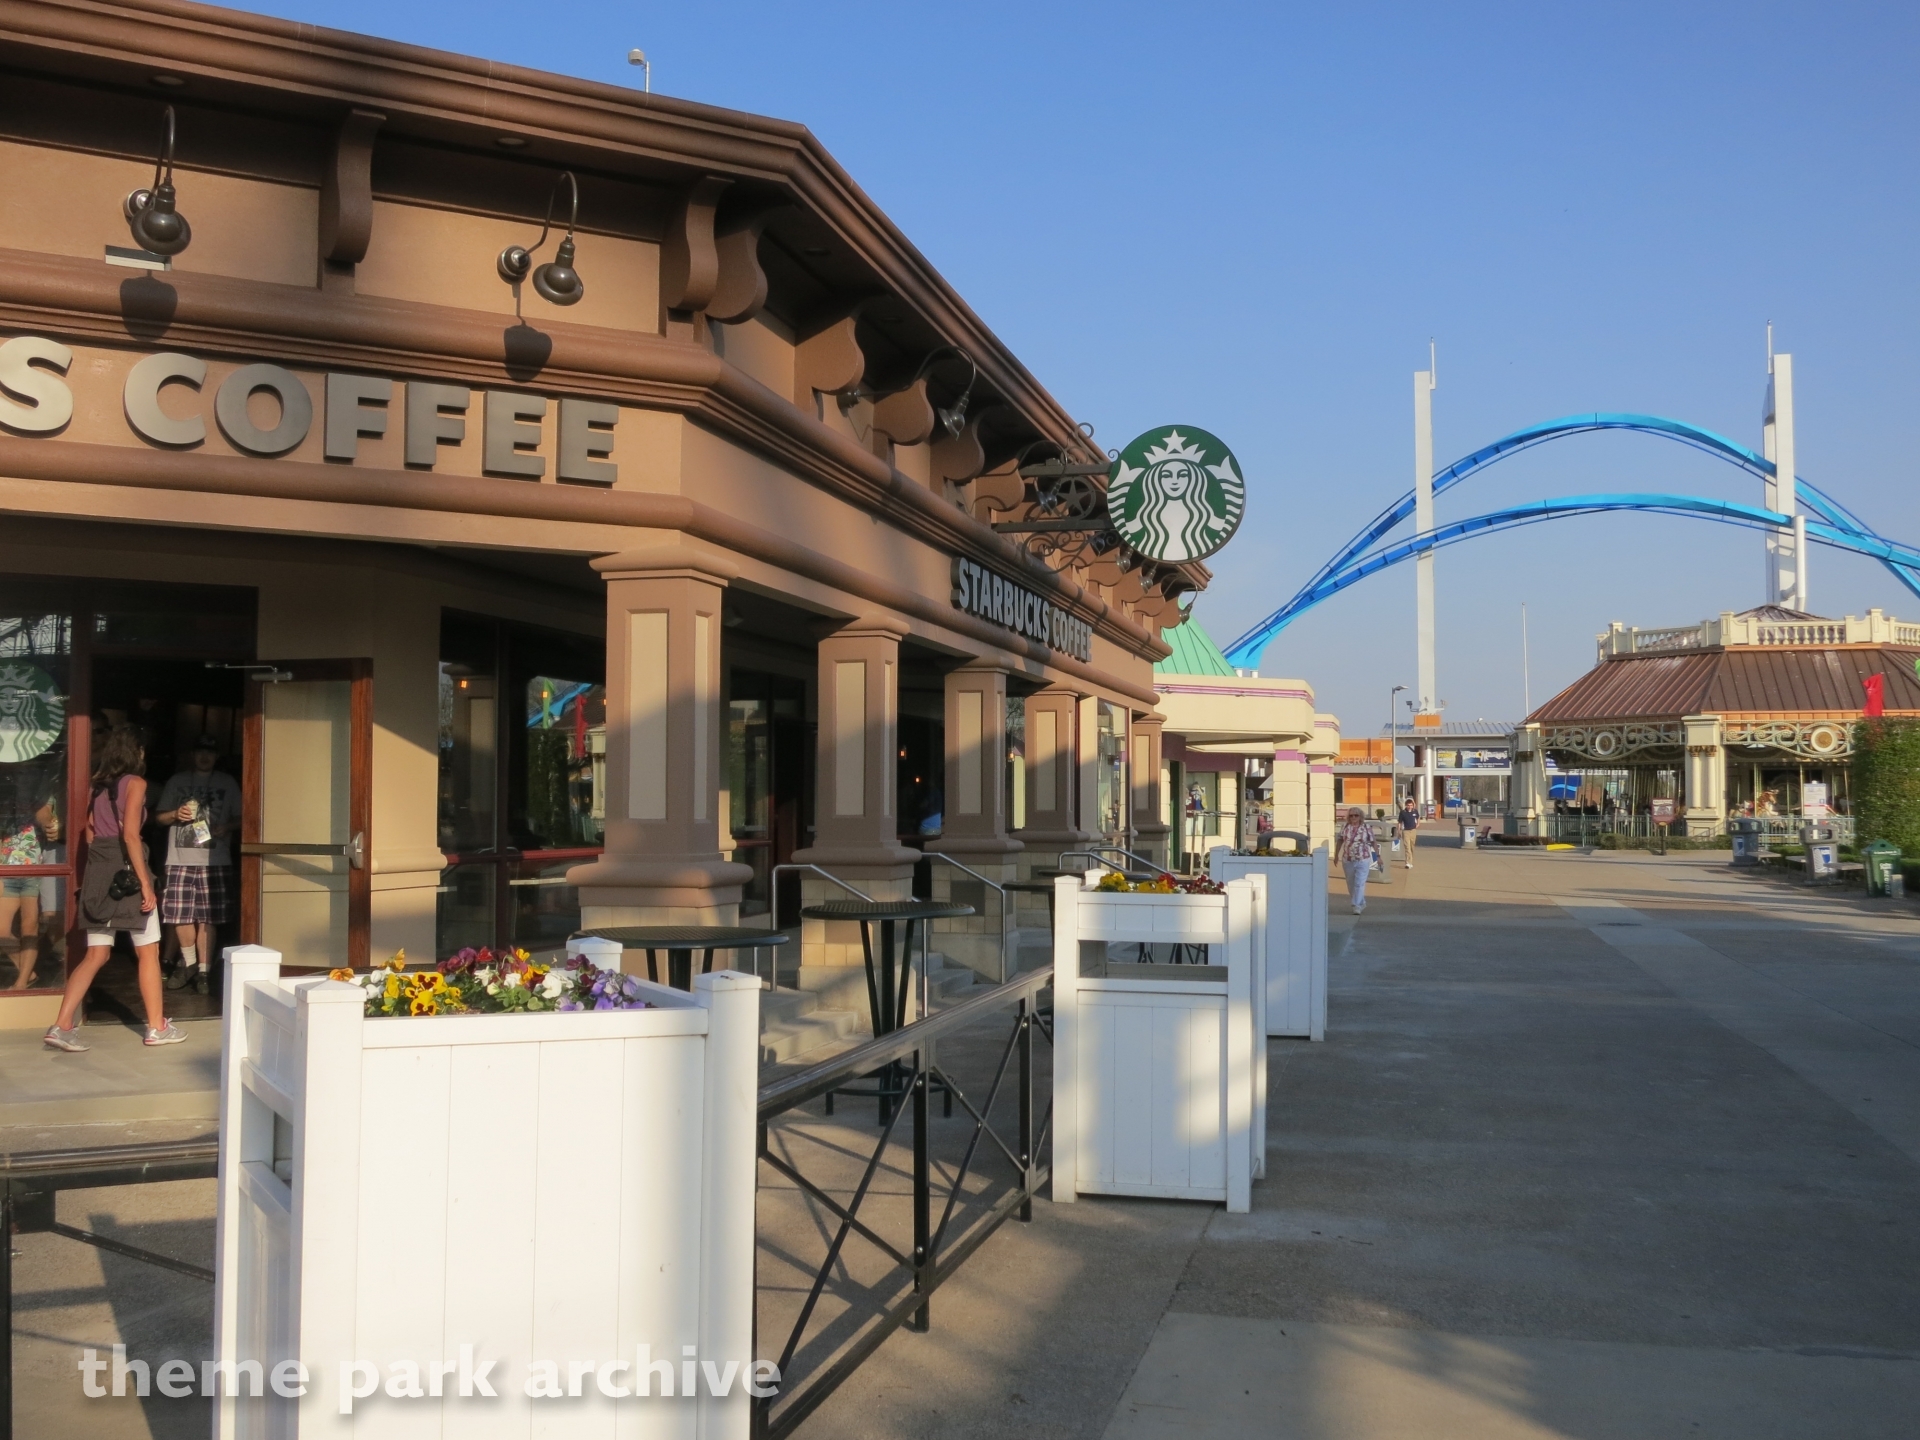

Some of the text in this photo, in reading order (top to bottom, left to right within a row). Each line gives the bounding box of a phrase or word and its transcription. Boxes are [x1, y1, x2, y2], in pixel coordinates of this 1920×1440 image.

[123, 352, 618, 484] COFFEE
[954, 556, 1093, 662] STARBUCKS COFFEE
